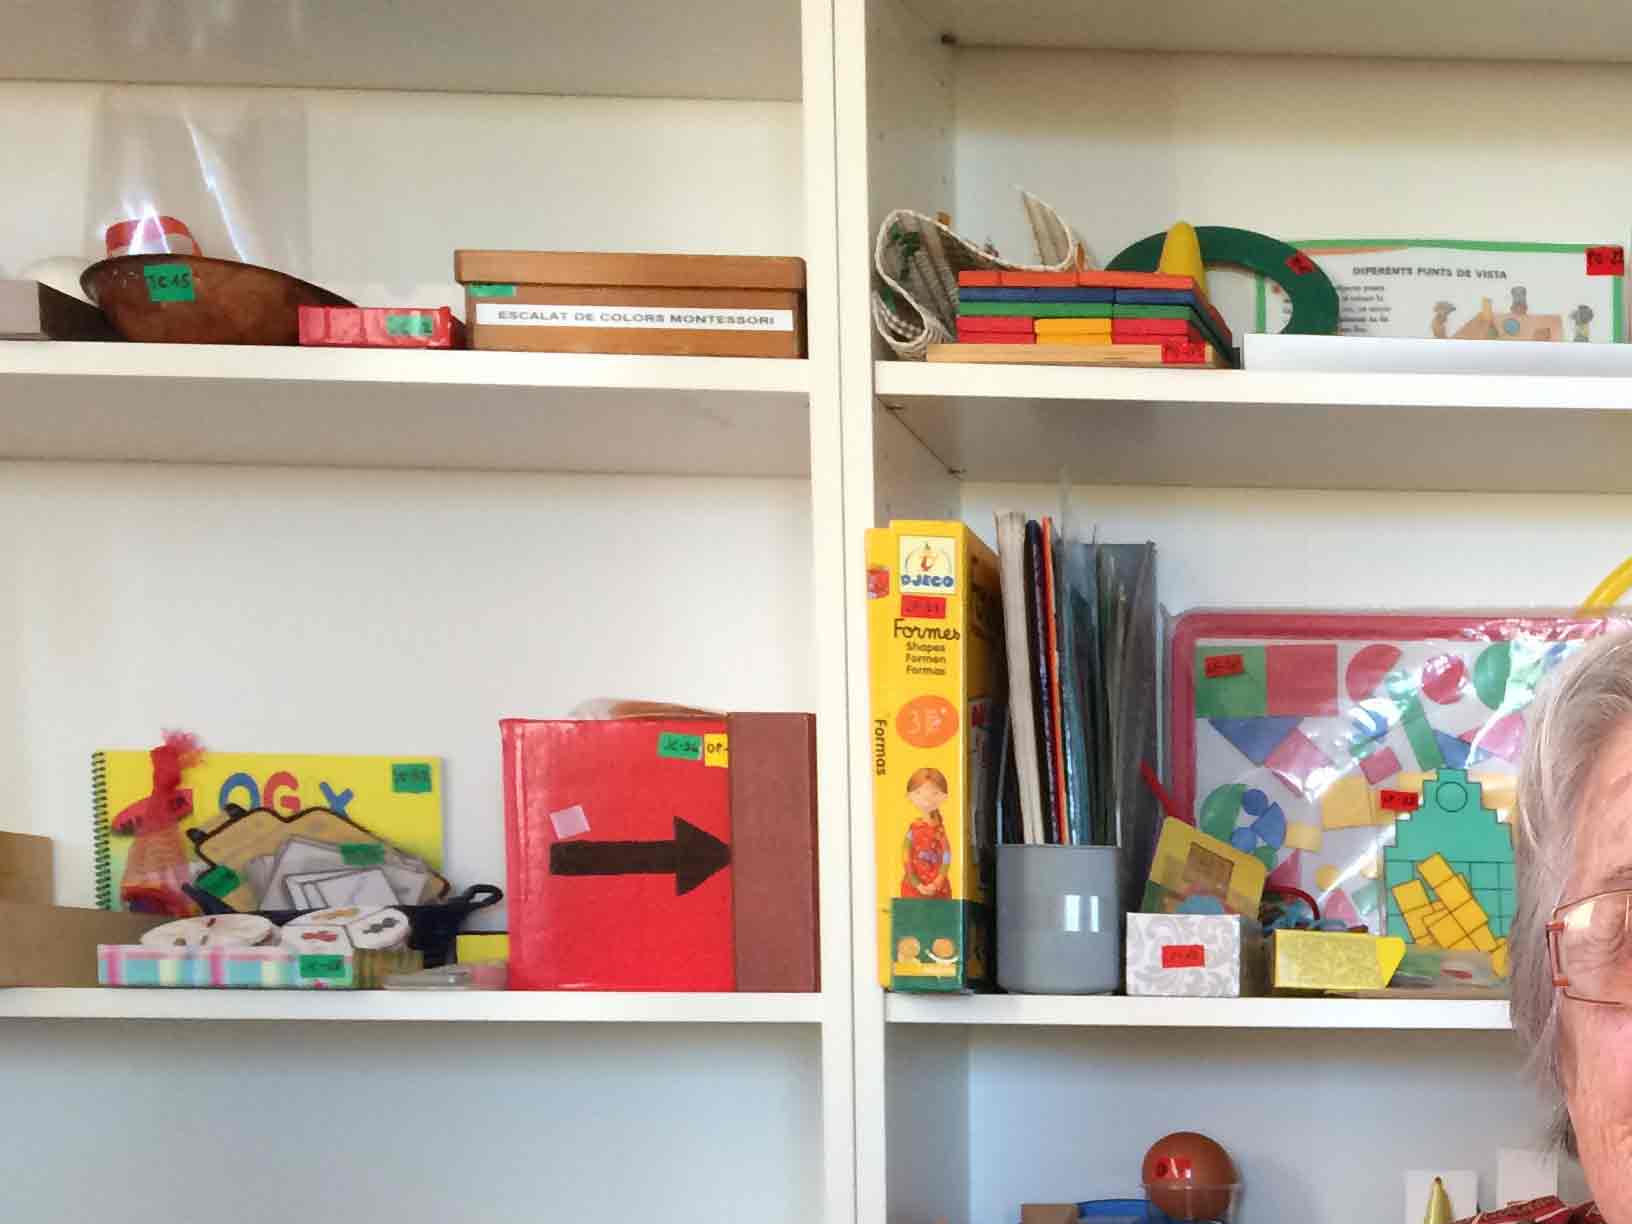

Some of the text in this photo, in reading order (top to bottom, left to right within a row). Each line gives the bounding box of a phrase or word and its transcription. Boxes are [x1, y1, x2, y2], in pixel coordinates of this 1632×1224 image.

[1416, 267, 1452, 277] PUNTS
[1456, 269, 1472, 278] DE
[1475, 269, 1508, 280] VISTA
[498, 309, 775, 326] ESCALAT DE COLORS MONTESSORI
[901, 575, 954, 588] DJECO
[893, 618, 961, 641] Formes
[906, 642, 945, 654] Shapes
[905, 654, 946, 664] Formen
[906, 666, 945, 676] Formas
[873, 718, 888, 777] Formas
